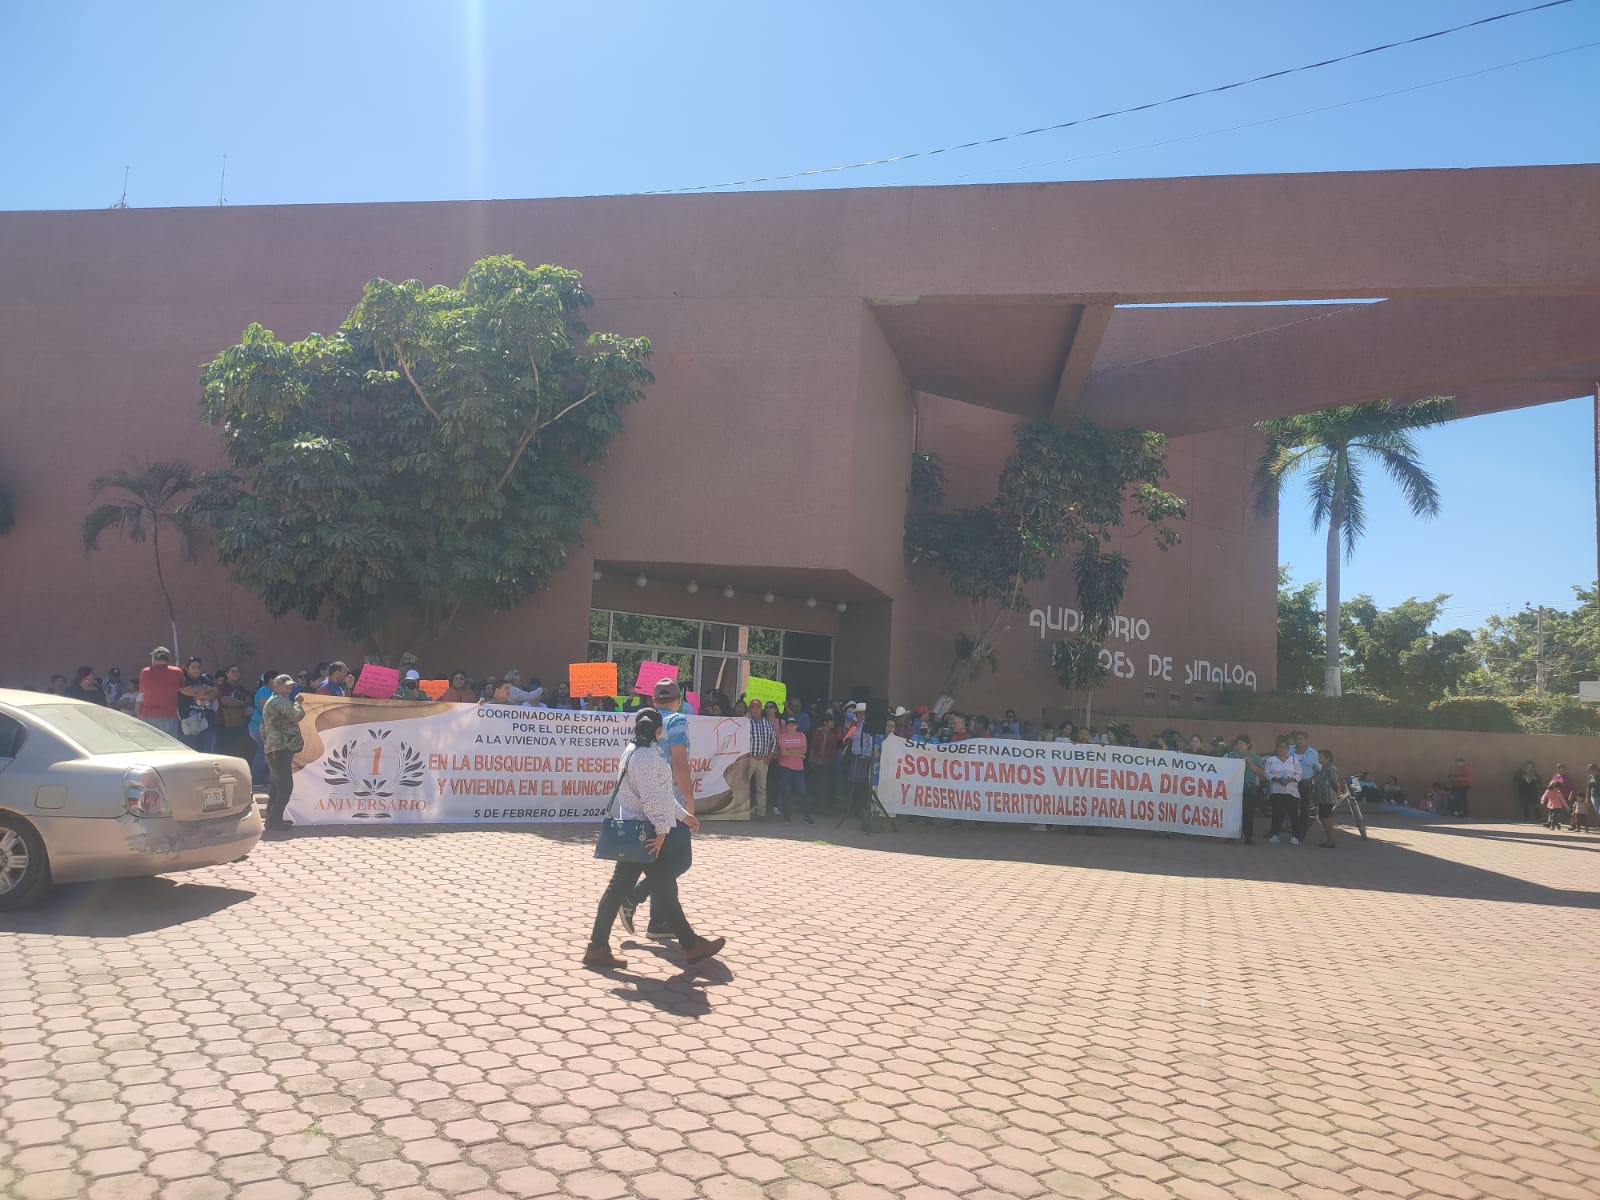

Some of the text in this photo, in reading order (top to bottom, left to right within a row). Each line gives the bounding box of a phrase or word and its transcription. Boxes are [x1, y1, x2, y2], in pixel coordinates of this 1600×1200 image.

[1149, 654, 1173, 681] DE
[1184, 659, 1257, 692] SINALOA
[477, 708, 630, 723] COORDINADORA ESTATAL Y
[512, 722, 635, 736] POR EL DERECHO HUM
[475, 734, 484, 744] A
[486, 735, 502, 745] LA
[504, 735, 557, 746] VIVIENDA
[560, 737, 568, 746] Y
[569, 737, 620, 747] RESERVA
[369, 746, 382, 776] 1
[428, 753, 448, 771] EN
[452, 754, 471, 771] LA
[473, 754, 552, 773] BUSQUEDA
[554, 756, 574, 773] DE
[576, 757, 620, 773] RESER
[936, 743, 1046, 760] GOBERNADOR
[1051, 749, 1107, 763] RUBÉN
[1112, 753, 1168, 768] ROCHA
[1171, 758, 1218, 774] MOYA
[896, 753, 1228, 801] ¡SOLICITAMOS VIVIENDA DIGNA
[437, 778, 618, 796] Y VIVIENDA EN EL MUNICIP
[313, 798, 428, 811] ANIVERSARIO
[473, 808, 607, 818] 5 DE FEBRERO DEL 2024
[901, 783, 1224, 829] Y RESERVAS TERRITORIALES PARA LOS SIN CASA!
